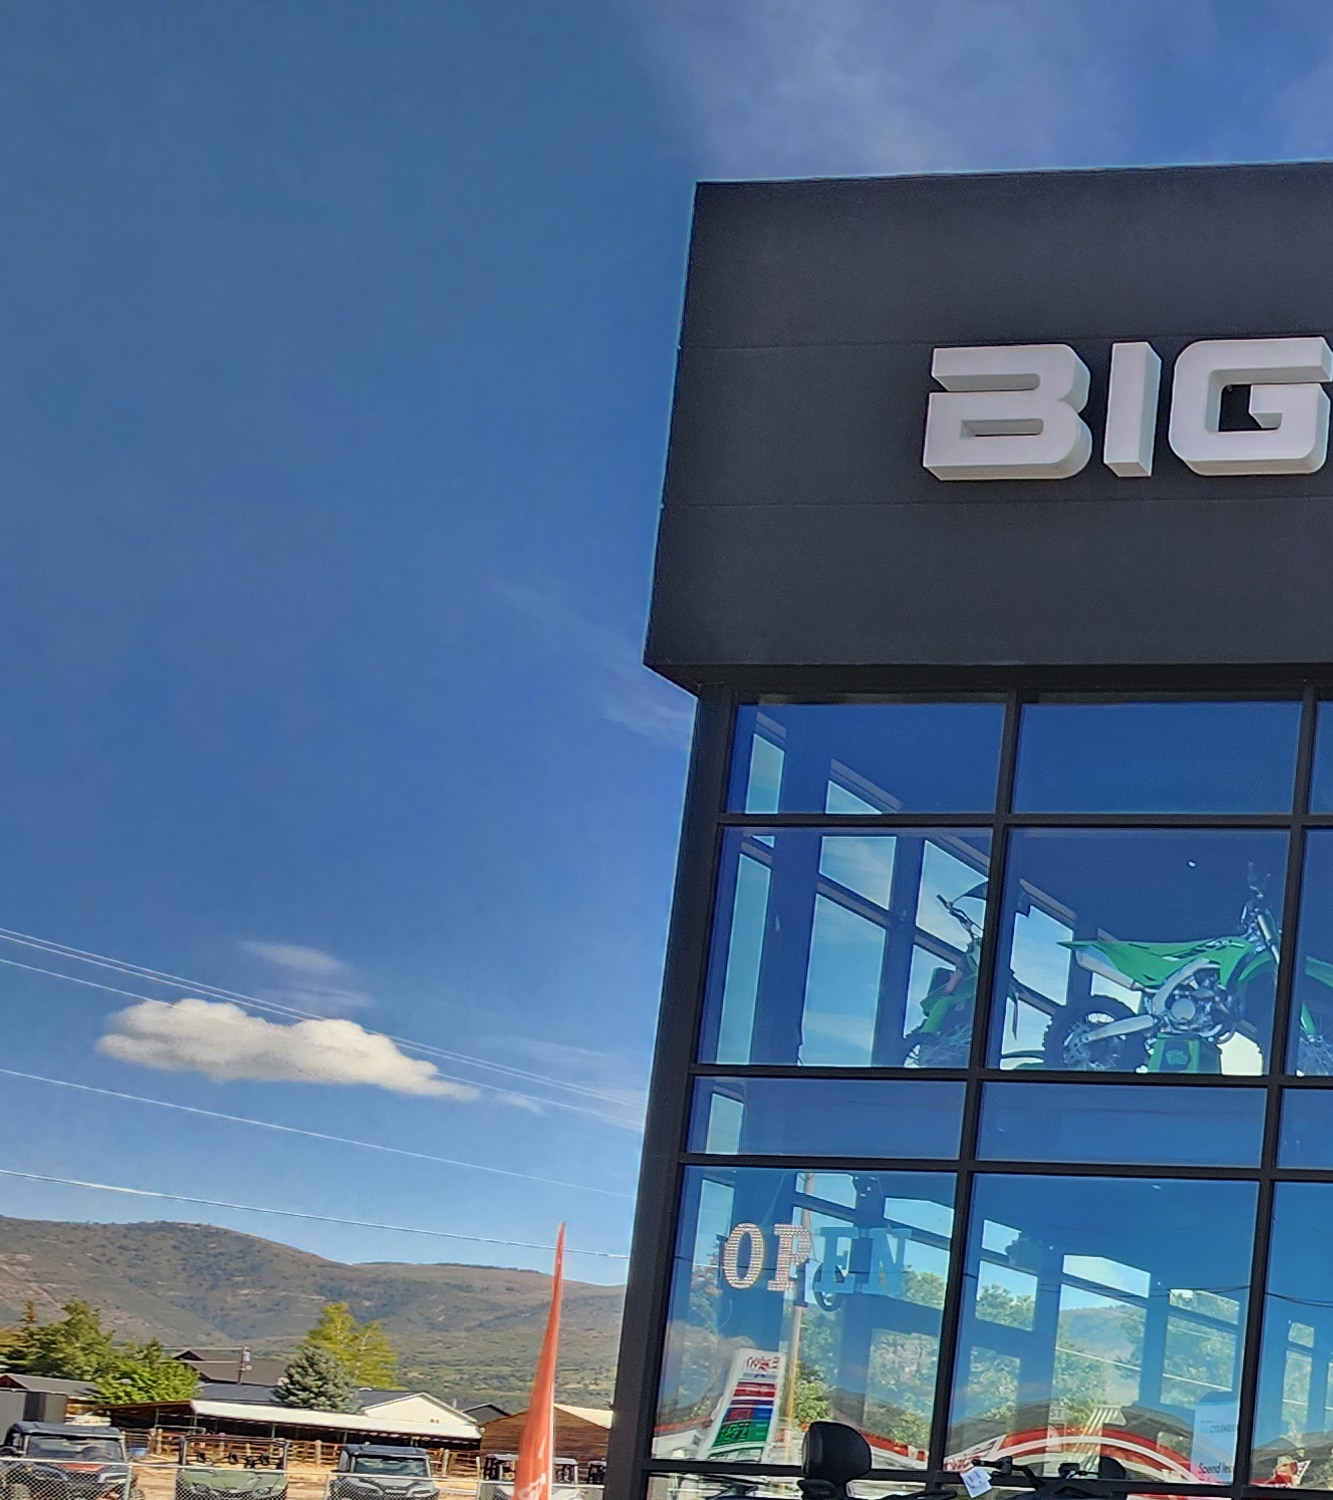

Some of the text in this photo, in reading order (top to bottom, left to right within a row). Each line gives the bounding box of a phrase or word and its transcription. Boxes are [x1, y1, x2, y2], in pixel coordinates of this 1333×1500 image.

[922, 336, 1333, 481] BIG
[722, 1222, 912, 1294] OPEN
[1198, 1462, 1221, 1476] Spend
